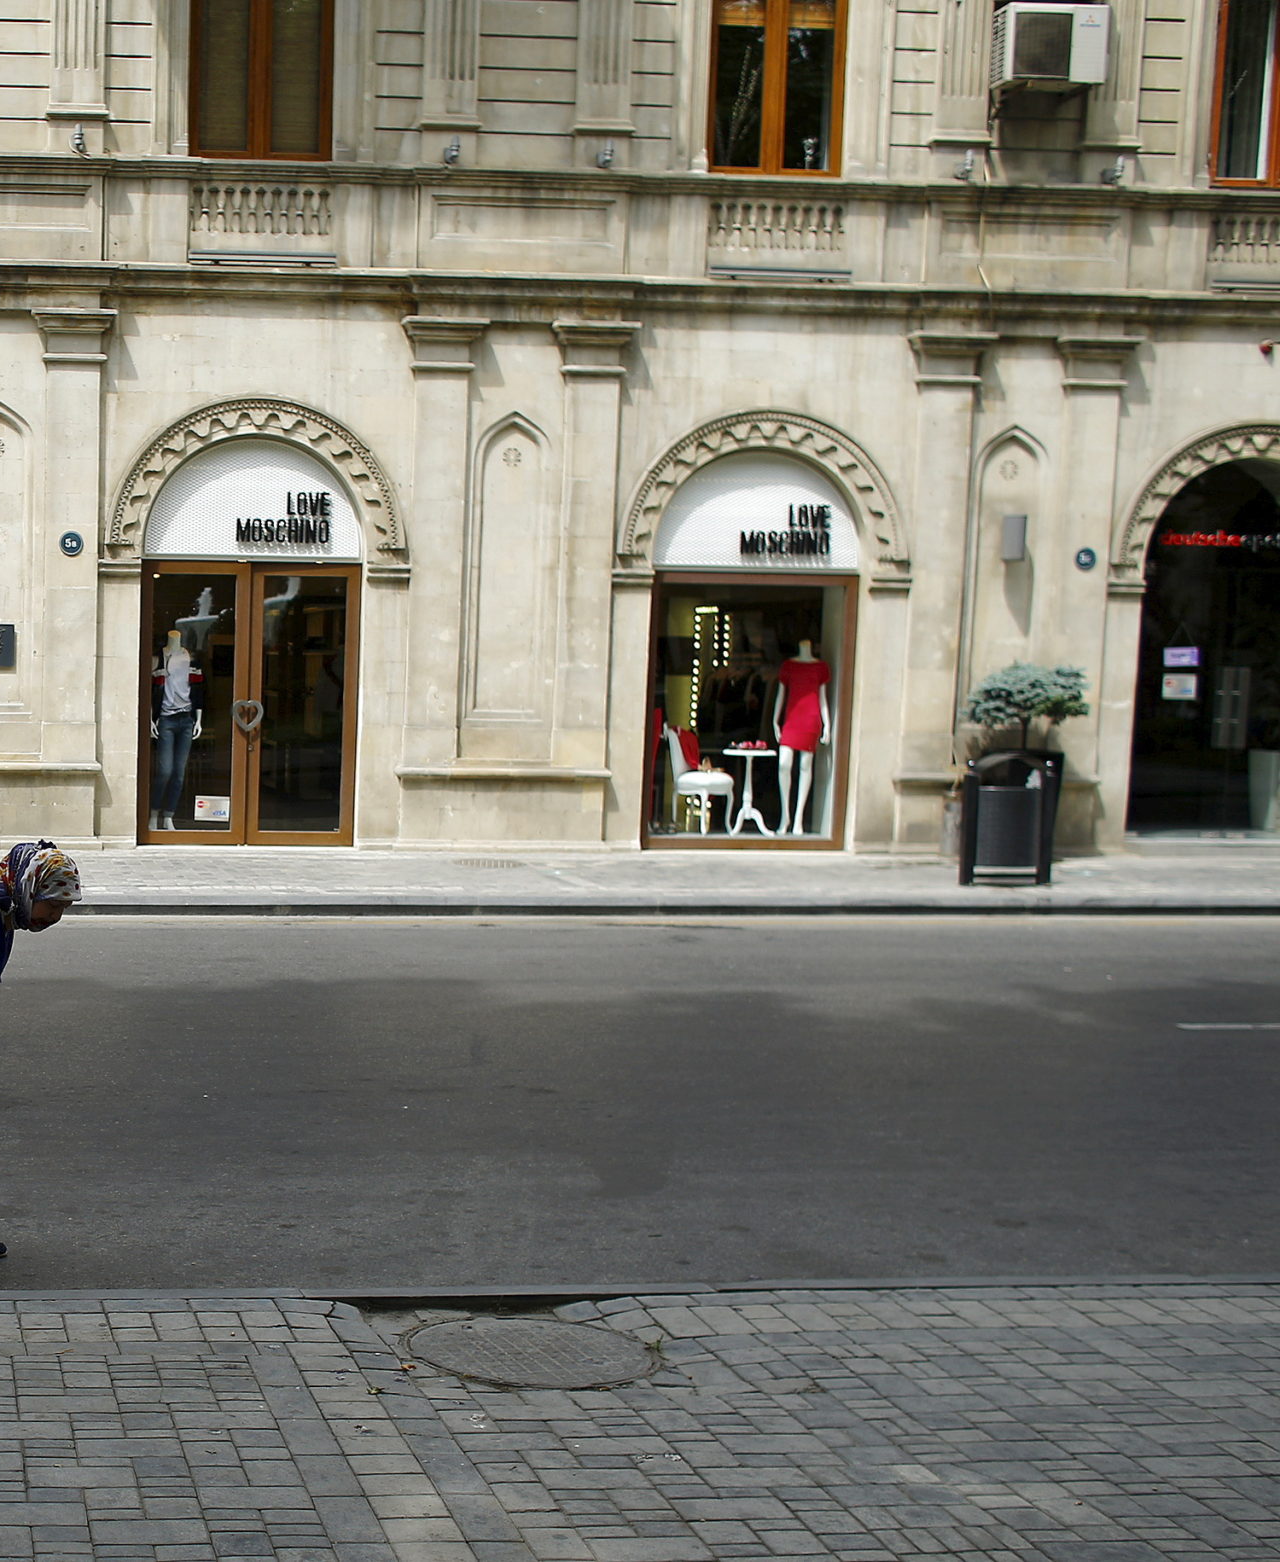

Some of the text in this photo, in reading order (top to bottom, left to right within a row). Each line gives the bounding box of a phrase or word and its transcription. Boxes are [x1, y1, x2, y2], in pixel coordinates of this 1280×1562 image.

[286, 491, 330, 516] LOVE
[788, 503, 831, 528] LOVE
[235, 518, 330, 543] MOSCHINO
[739, 530, 831, 555] MOSCHINO
